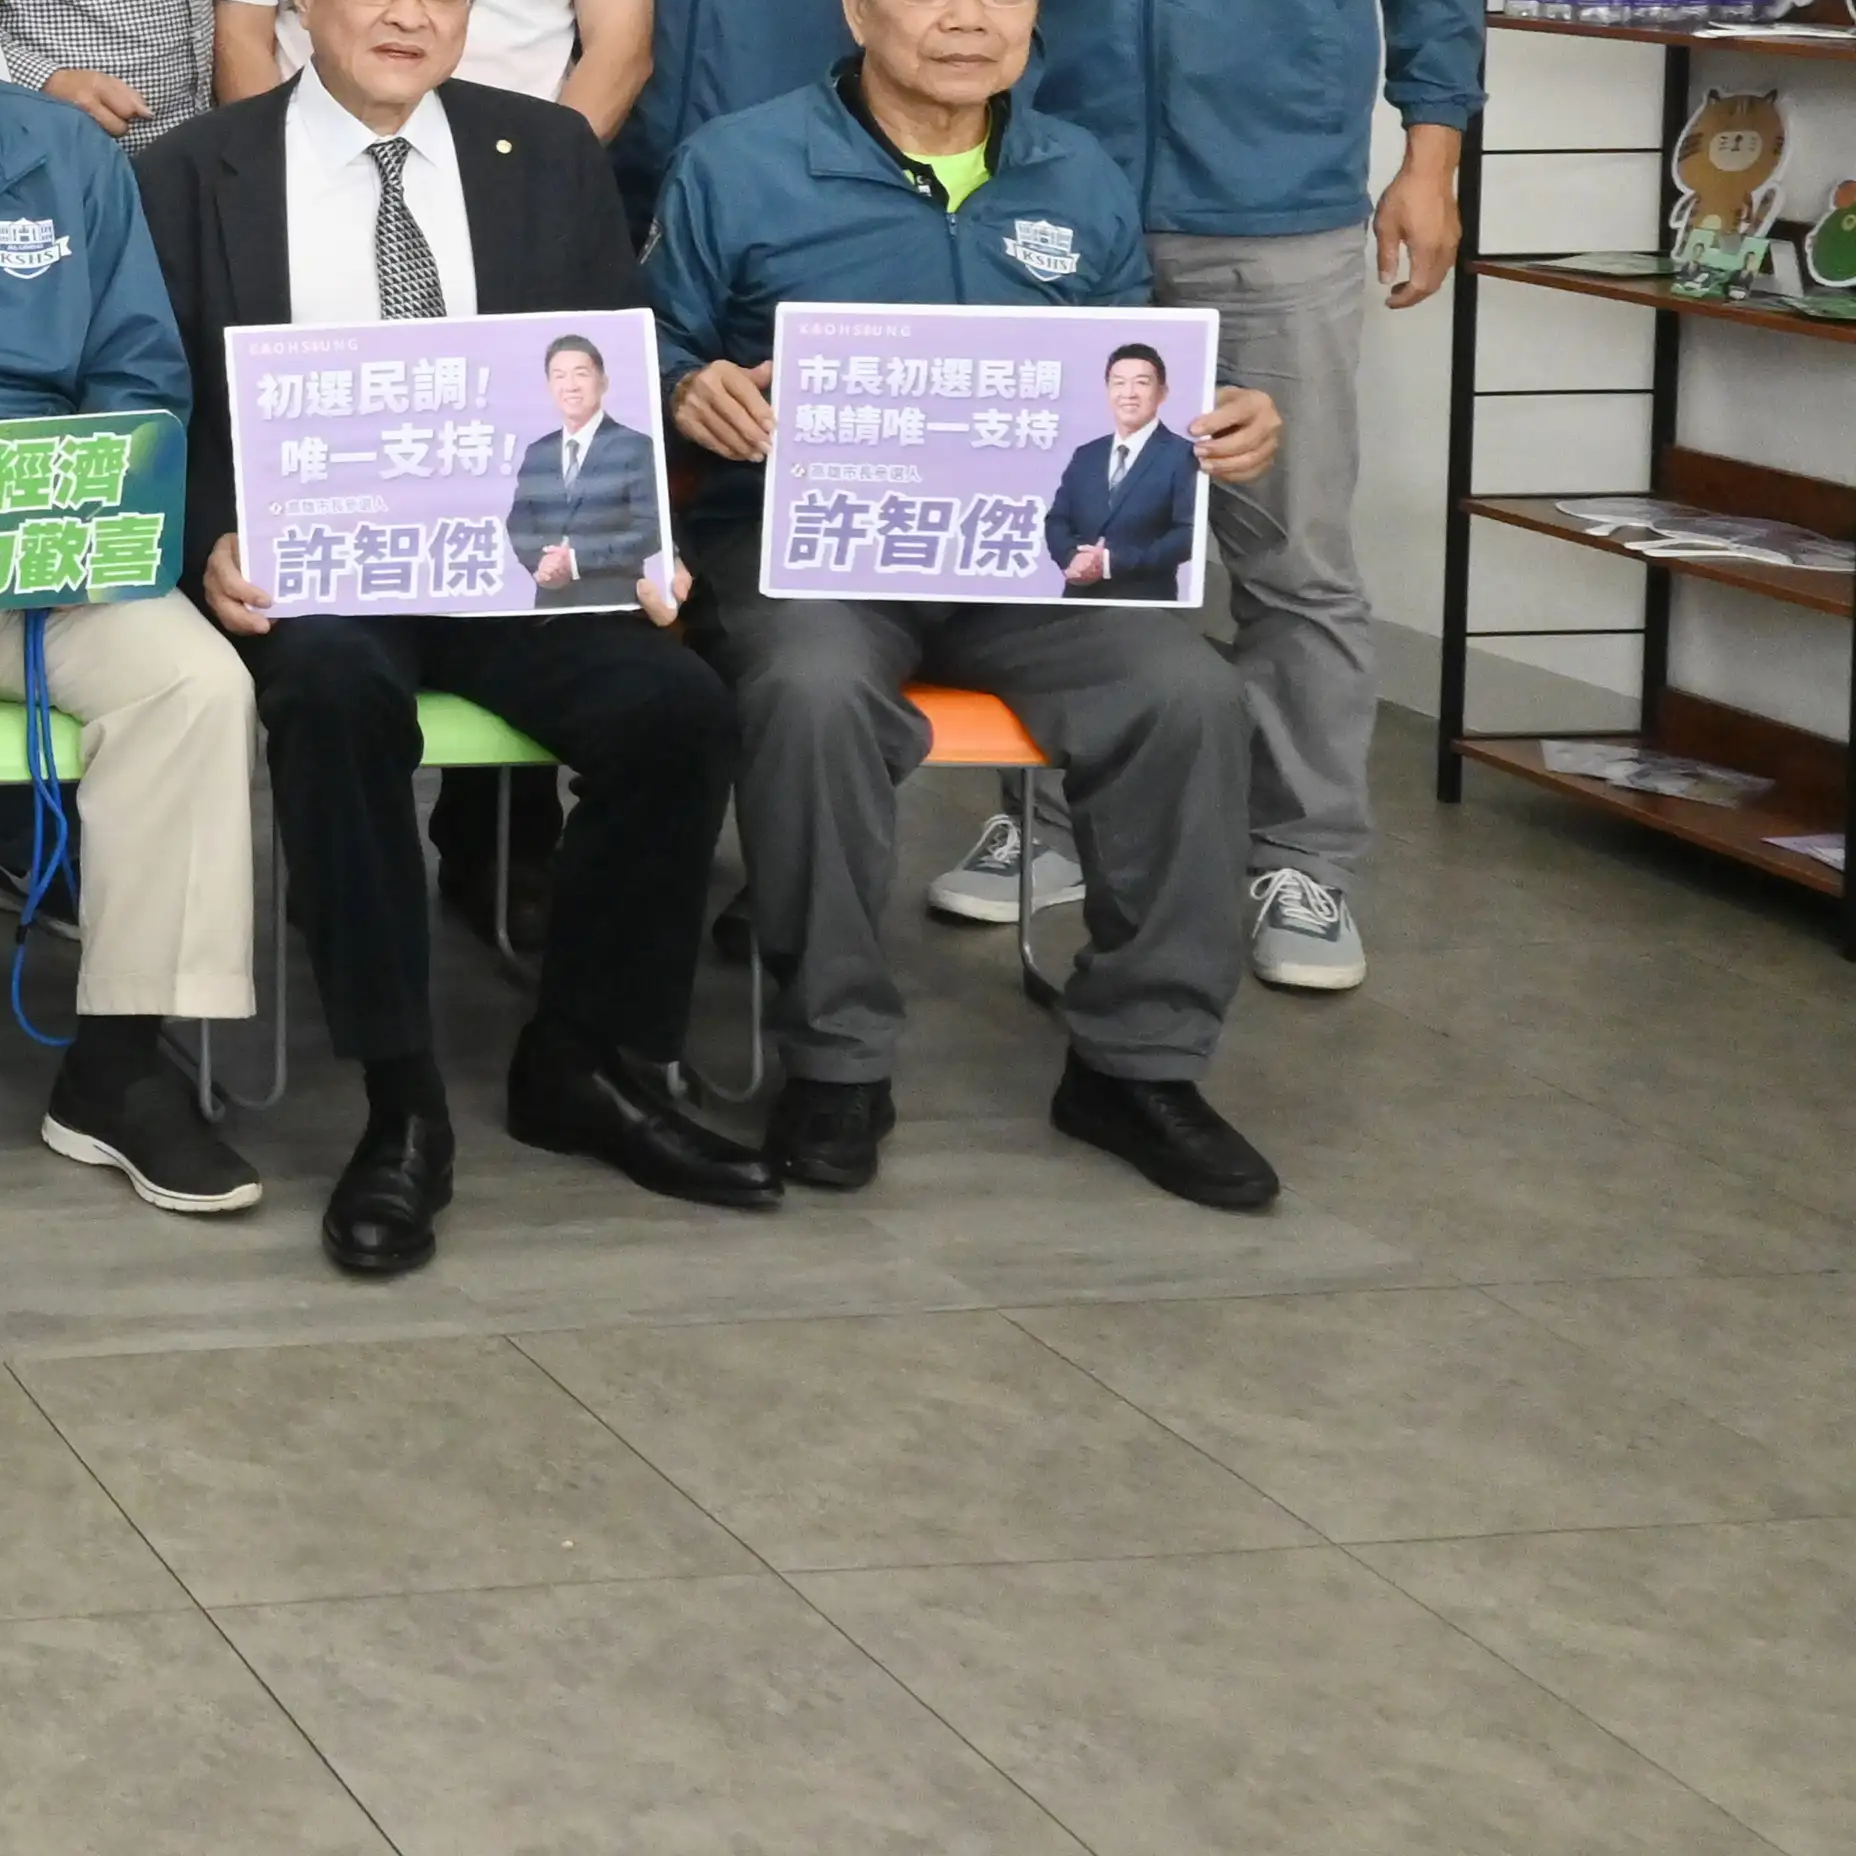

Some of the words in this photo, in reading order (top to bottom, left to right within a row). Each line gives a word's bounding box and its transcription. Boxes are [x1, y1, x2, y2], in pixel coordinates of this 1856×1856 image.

[0, 250, 54, 265] KSHS
[249, 338, 358, 356] KAOHSIUNG
[797, 353, 1063, 402] 市長初選民調
[793, 403, 1060, 452] 懇請唯一支持
[785, 489, 1044, 578] 許智傑
[274, 516, 504, 603] 許智傑
